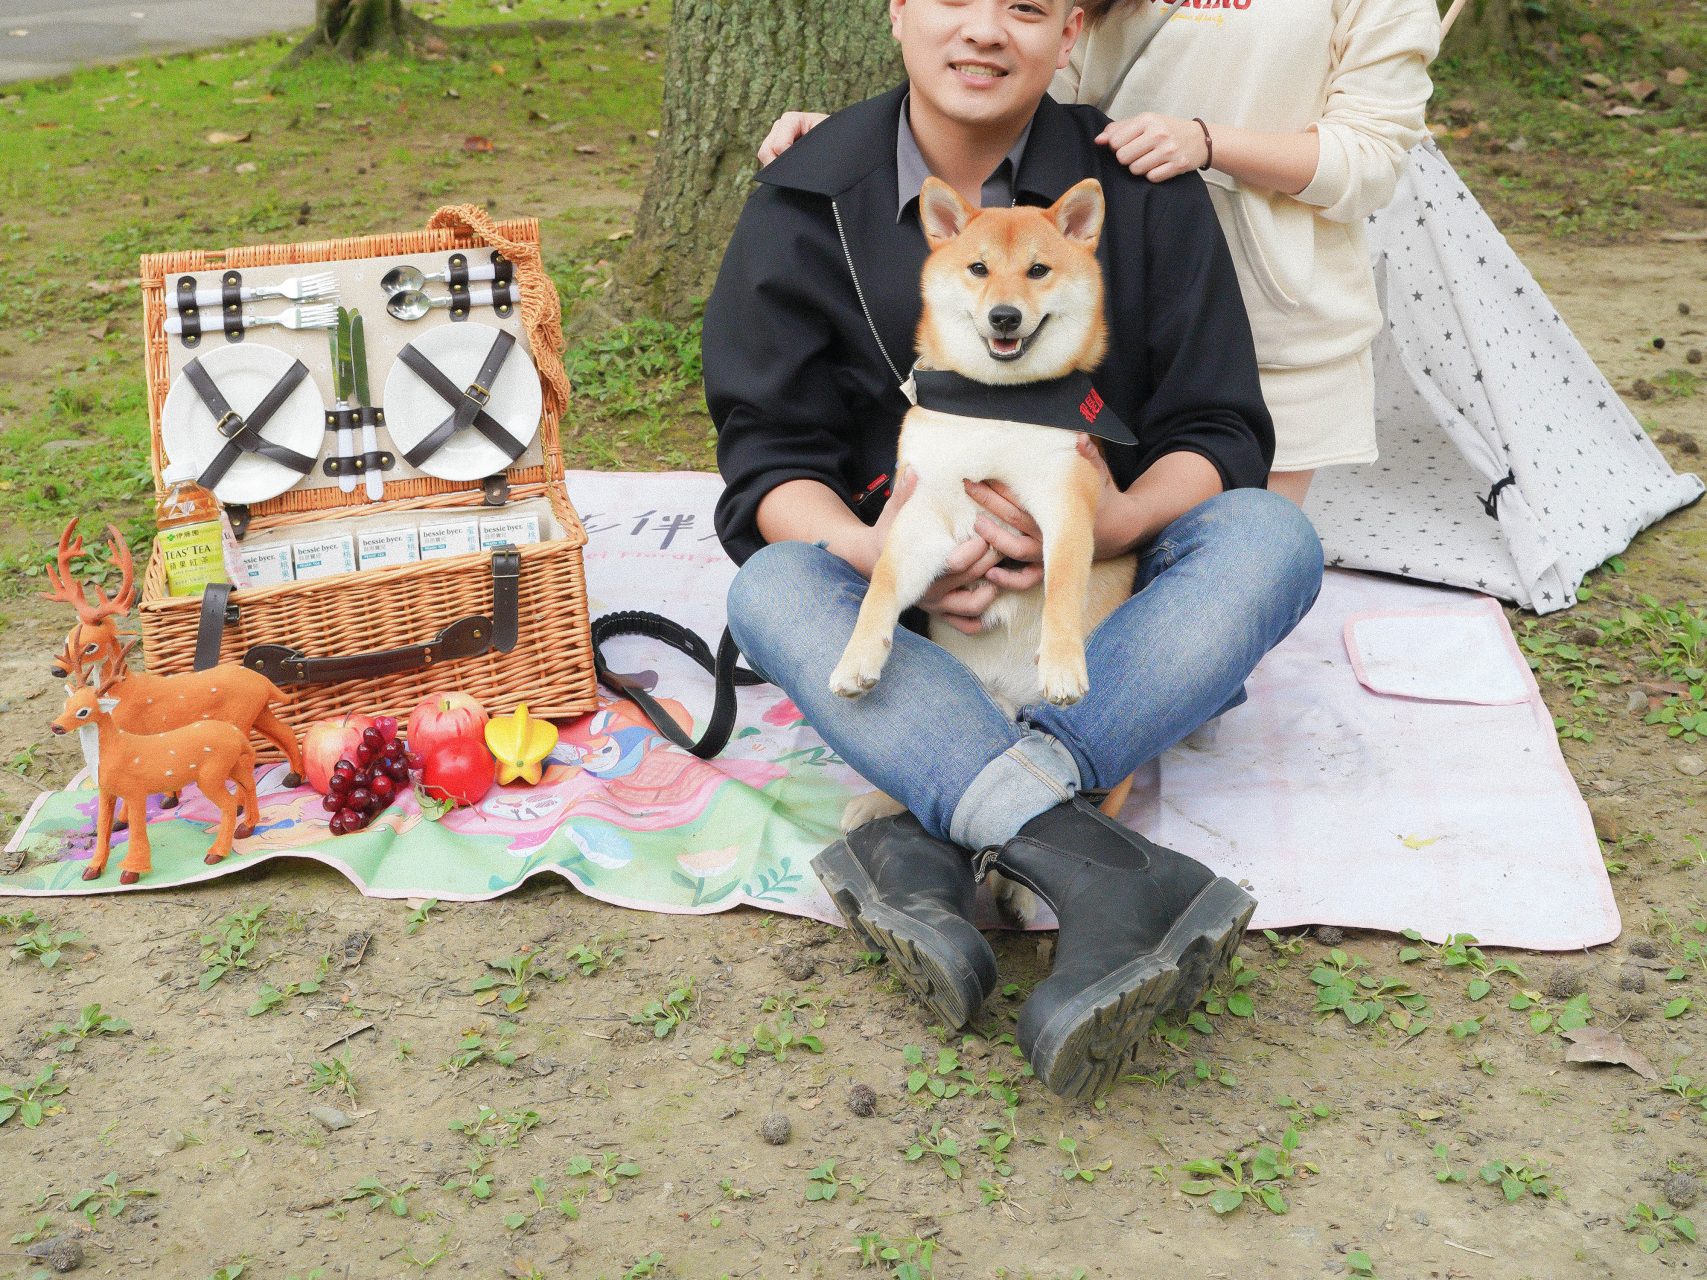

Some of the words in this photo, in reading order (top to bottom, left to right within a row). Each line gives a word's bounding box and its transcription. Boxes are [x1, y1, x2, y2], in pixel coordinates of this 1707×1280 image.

[423, 529, 446, 538] bessie
[483, 525, 506, 534] bessie
[363, 538, 386, 546] bessie
[192, 544, 211, 556] TEA
[297, 546, 321, 555] bessie
